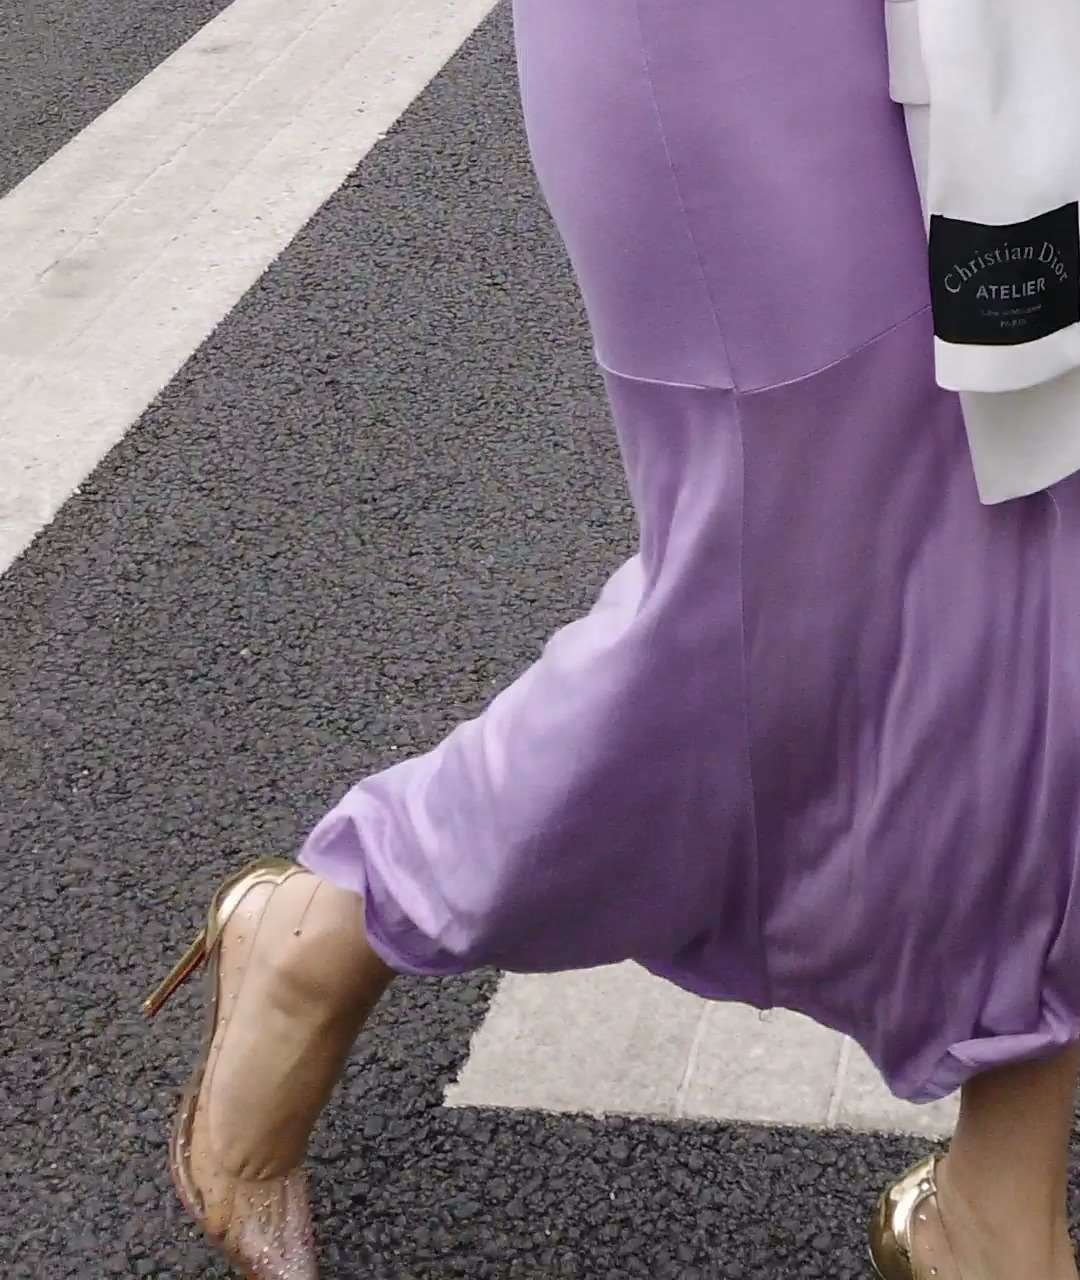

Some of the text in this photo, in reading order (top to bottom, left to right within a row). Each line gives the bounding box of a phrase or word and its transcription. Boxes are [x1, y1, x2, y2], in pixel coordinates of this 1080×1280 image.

[944, 241, 1068, 293] Christian Dior
[976, 277, 1046, 300] ATELIER
